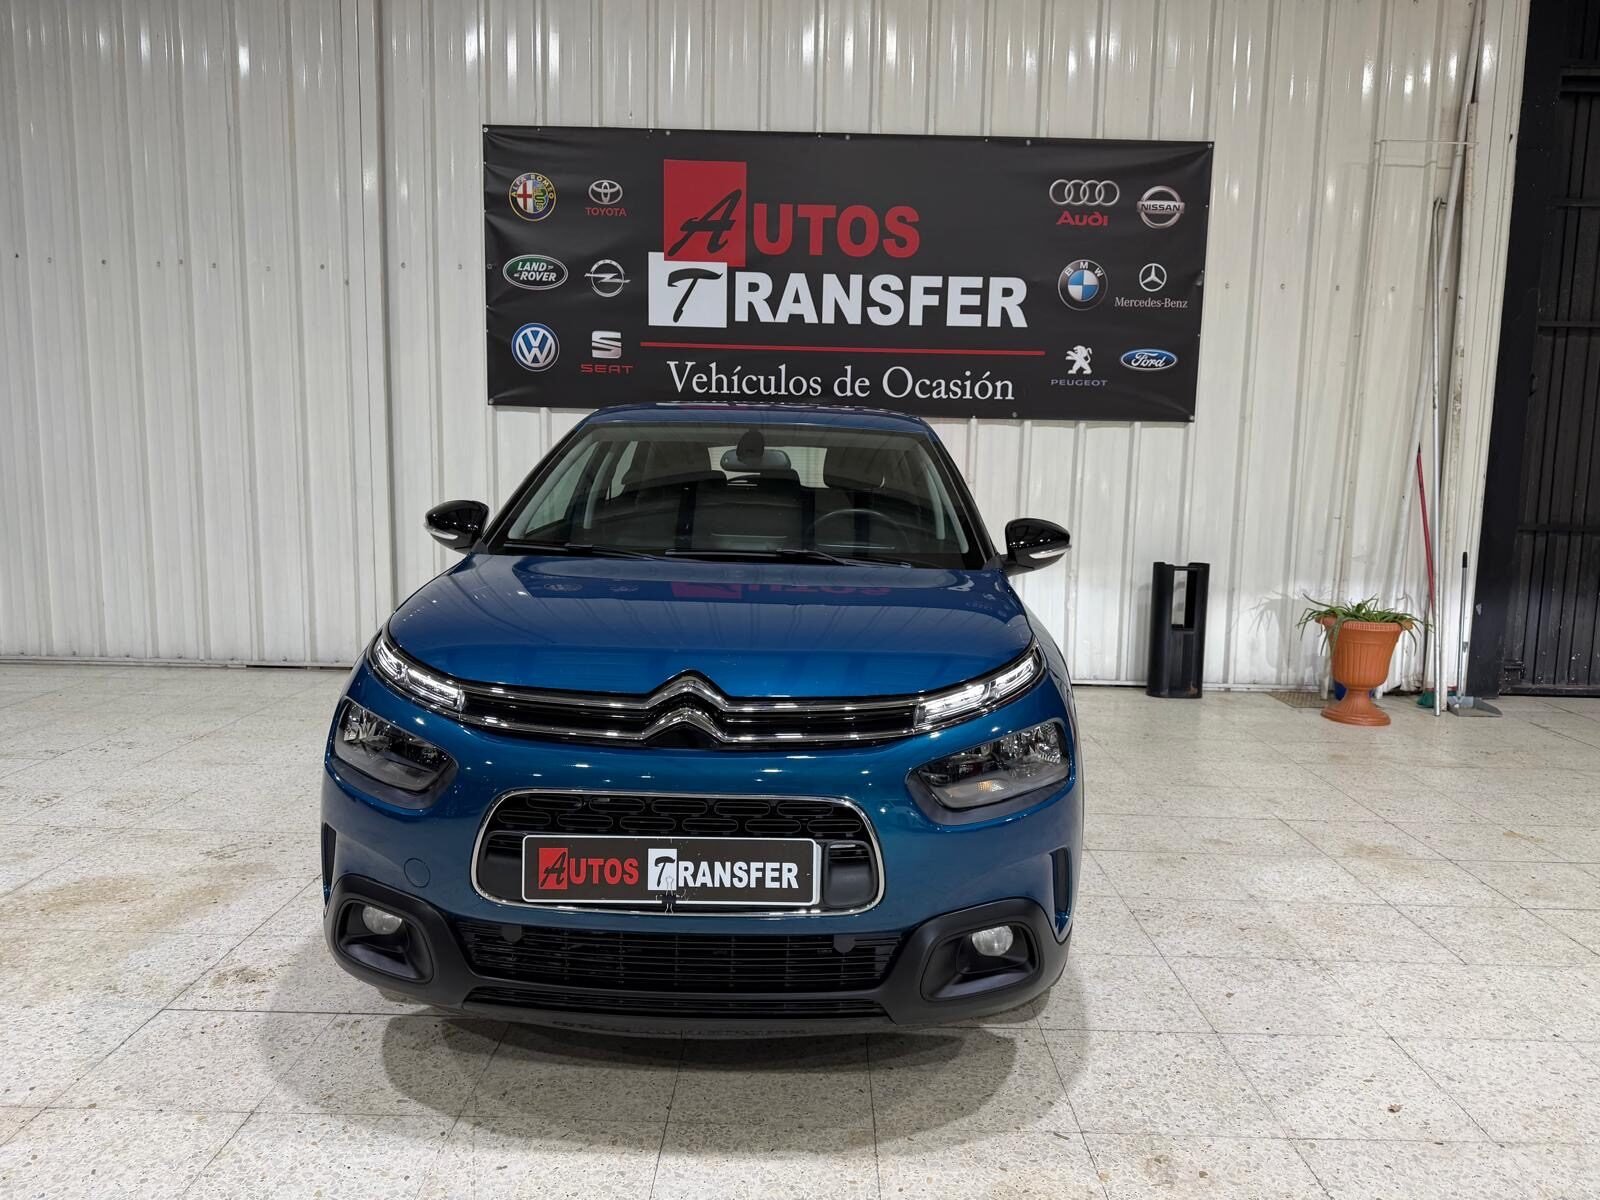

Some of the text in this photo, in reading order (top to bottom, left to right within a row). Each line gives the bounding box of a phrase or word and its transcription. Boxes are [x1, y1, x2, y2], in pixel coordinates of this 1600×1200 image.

[585, 207, 627, 217] TOYOTA
[1141, 203, 1181, 212] NISSAN
[667, 188, 921, 259] AUTOS
[1056, 210, 1109, 226] Audi
[517, 261, 548, 272] LAND
[520, 271, 557, 282] ROVER
[667, 267, 1028, 328] TRANSFER
[1114, 296, 1189, 309] Mercedes-Benz
[1131, 352, 1167, 368] Ford
[581, 364, 633, 374] SEAT
[666, 361, 1015, 401] Vehículos de Ocasión
[540, 851, 799, 889] AUTOS TRANSFER
